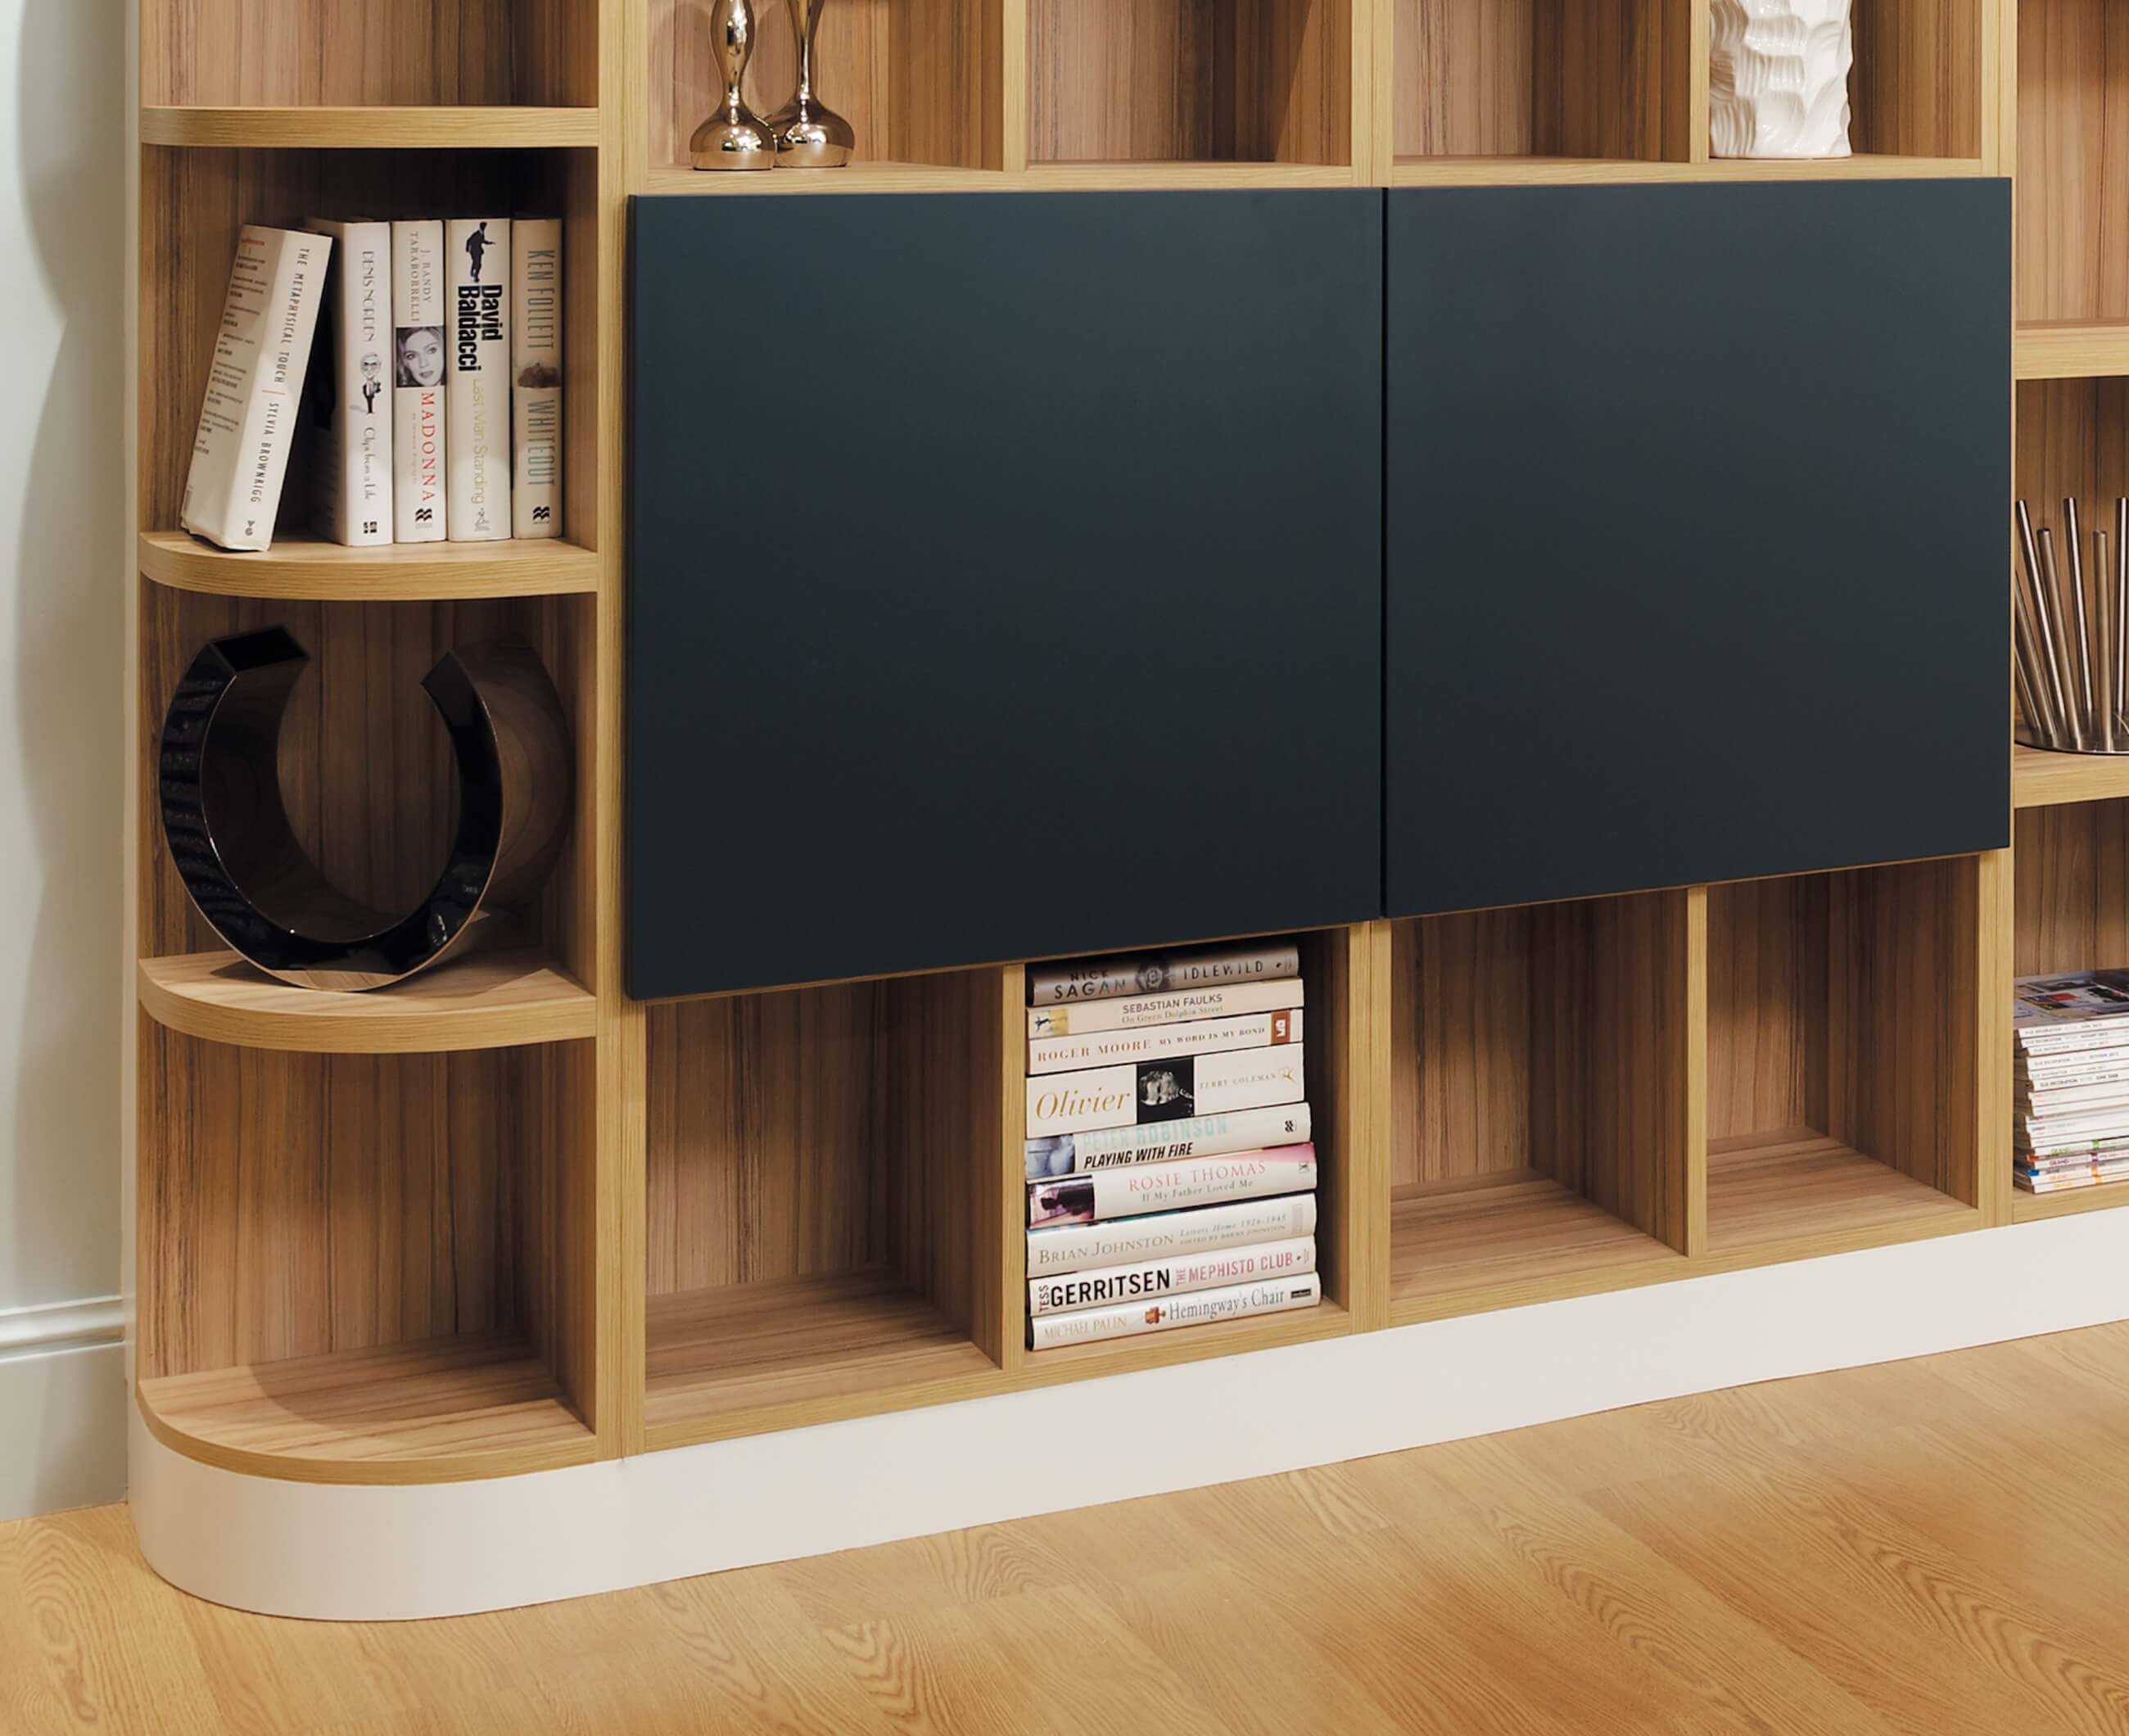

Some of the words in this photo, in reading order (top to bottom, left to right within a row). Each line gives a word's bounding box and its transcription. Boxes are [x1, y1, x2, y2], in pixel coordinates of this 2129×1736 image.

[296, 248, 310, 266] THE
[362, 251, 374, 287] DENIS
[527, 250, 555, 281] KEN
[409, 231, 419, 322] TARABORRELLI
[422, 262, 432, 302] RANDY
[281, 273, 305, 344] METAPHYSICAL
[481, 285, 503, 341] David
[527, 288, 555, 350] FOLLETT
[459, 285, 481, 371] Baldacci
[274, 351, 290, 383] TOUCH
[472, 379, 486, 406] Last
[264, 403, 280, 435] SYLVIA
[472, 411, 488, 441] Man
[421, 392, 436, 501] MADONNA
[527, 400, 555, 486] WHITEOUT
[250, 442, 272, 503] BROWNRIGG
[472, 445, 489, 504] Standing
[1055, 979, 1126, 1000] SAGAN
[1183, 961, 1263, 981] IDLEWILD
[1122, 1015, 1134, 1024] On
[1137, 1011, 1161, 1022] Green
[1198, 1005, 1223, 1015] Street
[1123, 998, 1180, 1015] SEBASTIAN
[1183, 993, 1223, 1007] FAULKS
[1037, 1047, 1091, 1062] ROGER
[1098, 1039, 1151, 1056] MOORE
[1159, 1038, 1173, 1047] MY
[1177, 1034, 1206, 1043] WORD
[1209, 1032, 1218, 1040] IS
[1223, 1029, 1237, 1038] MY
[1239, 1027, 1266, 1037] BOND
[1200, 1079, 1228, 1089] TERRY
[1232, 1073, 1277, 1085] COLEMAN
[1036, 1087, 1131, 1121] Olivier
[1082, 1123, 1131, 1151] PETER
[1135, 1115, 1227, 1147] ROBINSON
[1084, 1150, 1132, 1169] PLAYING
[1136, 1146, 1164, 1162] WITH
[1168, 1142, 1194, 1156] FIRE
[1129, 1172, 1182, 1192] ROSIE
[1189, 1161, 1266, 1184] THOMAS
[1153, 1191, 1168, 1203] My
[1172, 1187, 1202, 1199] Father
[1207, 1182, 1235, 1194] Loved
[1238, 1179, 1254, 1190] Me
[1039, 1246, 1088, 1265] BRIAN
[1091, 1233, 1173, 1258] JOHNSTON
[1176, 1268, 1187, 1286] THE
[1188, 1258, 1254, 1282] MEPHISTO
[1260, 1251, 1293, 1271] CLUB
[1038, 1284, 1050, 1312] TESS
[1051, 1268, 1170, 1307] GERRITSEN
[1170, 1295, 1248, 1320] Hemingway's
[1251, 1287, 1284, 1308] Chair
[1044, 1322, 1088, 1340] MICHAEL
[1092, 1317, 1128, 1333] PALIN
